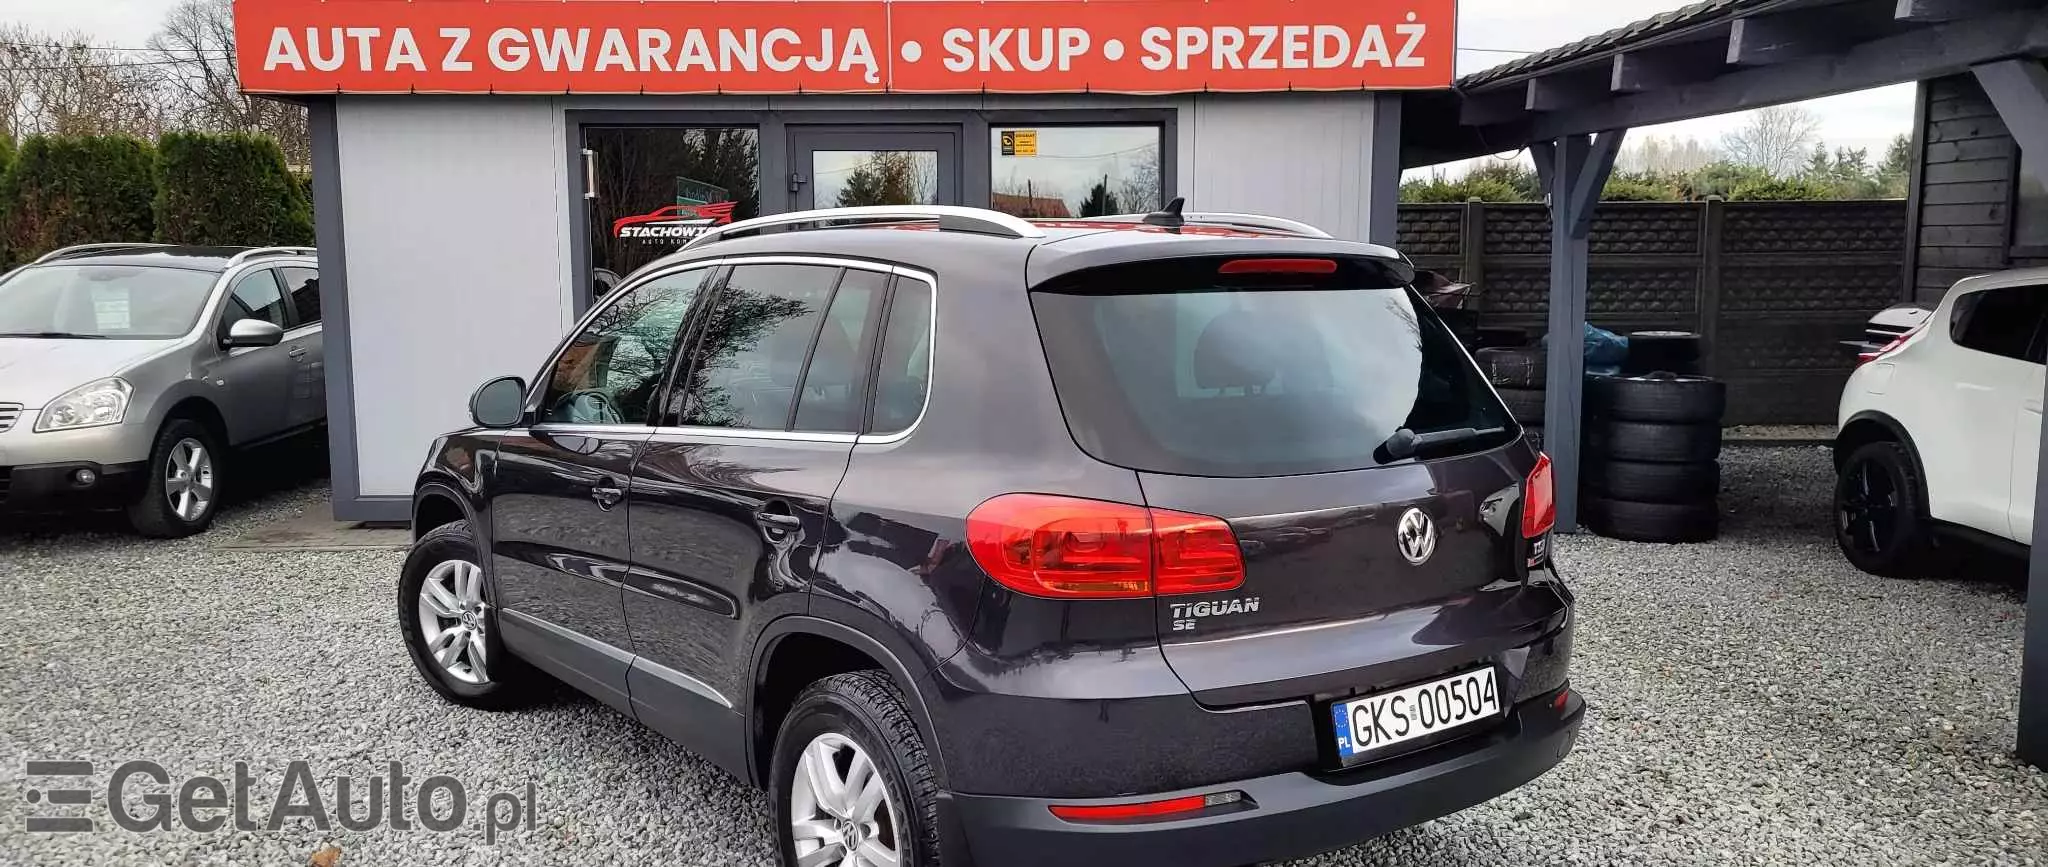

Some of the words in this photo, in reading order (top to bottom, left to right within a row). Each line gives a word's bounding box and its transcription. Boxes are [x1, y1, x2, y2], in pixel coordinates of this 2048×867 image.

[263, 27, 427, 72] AUTA
[439, 27, 473, 72] Z
[487, 27, 880, 84] GWARANCJĄ
[942, 27, 1091, 73] SKUP
[1140, 11, 1426, 71] SPRZEDAŻ
[1169, 597, 1260, 618] TIGUAN
[1172, 619, 1197, 631] SE
[1352, 695, 1410, 747] GKS
[1417, 671, 1497, 729] 00504
[1337, 737, 1352, 749] PL
